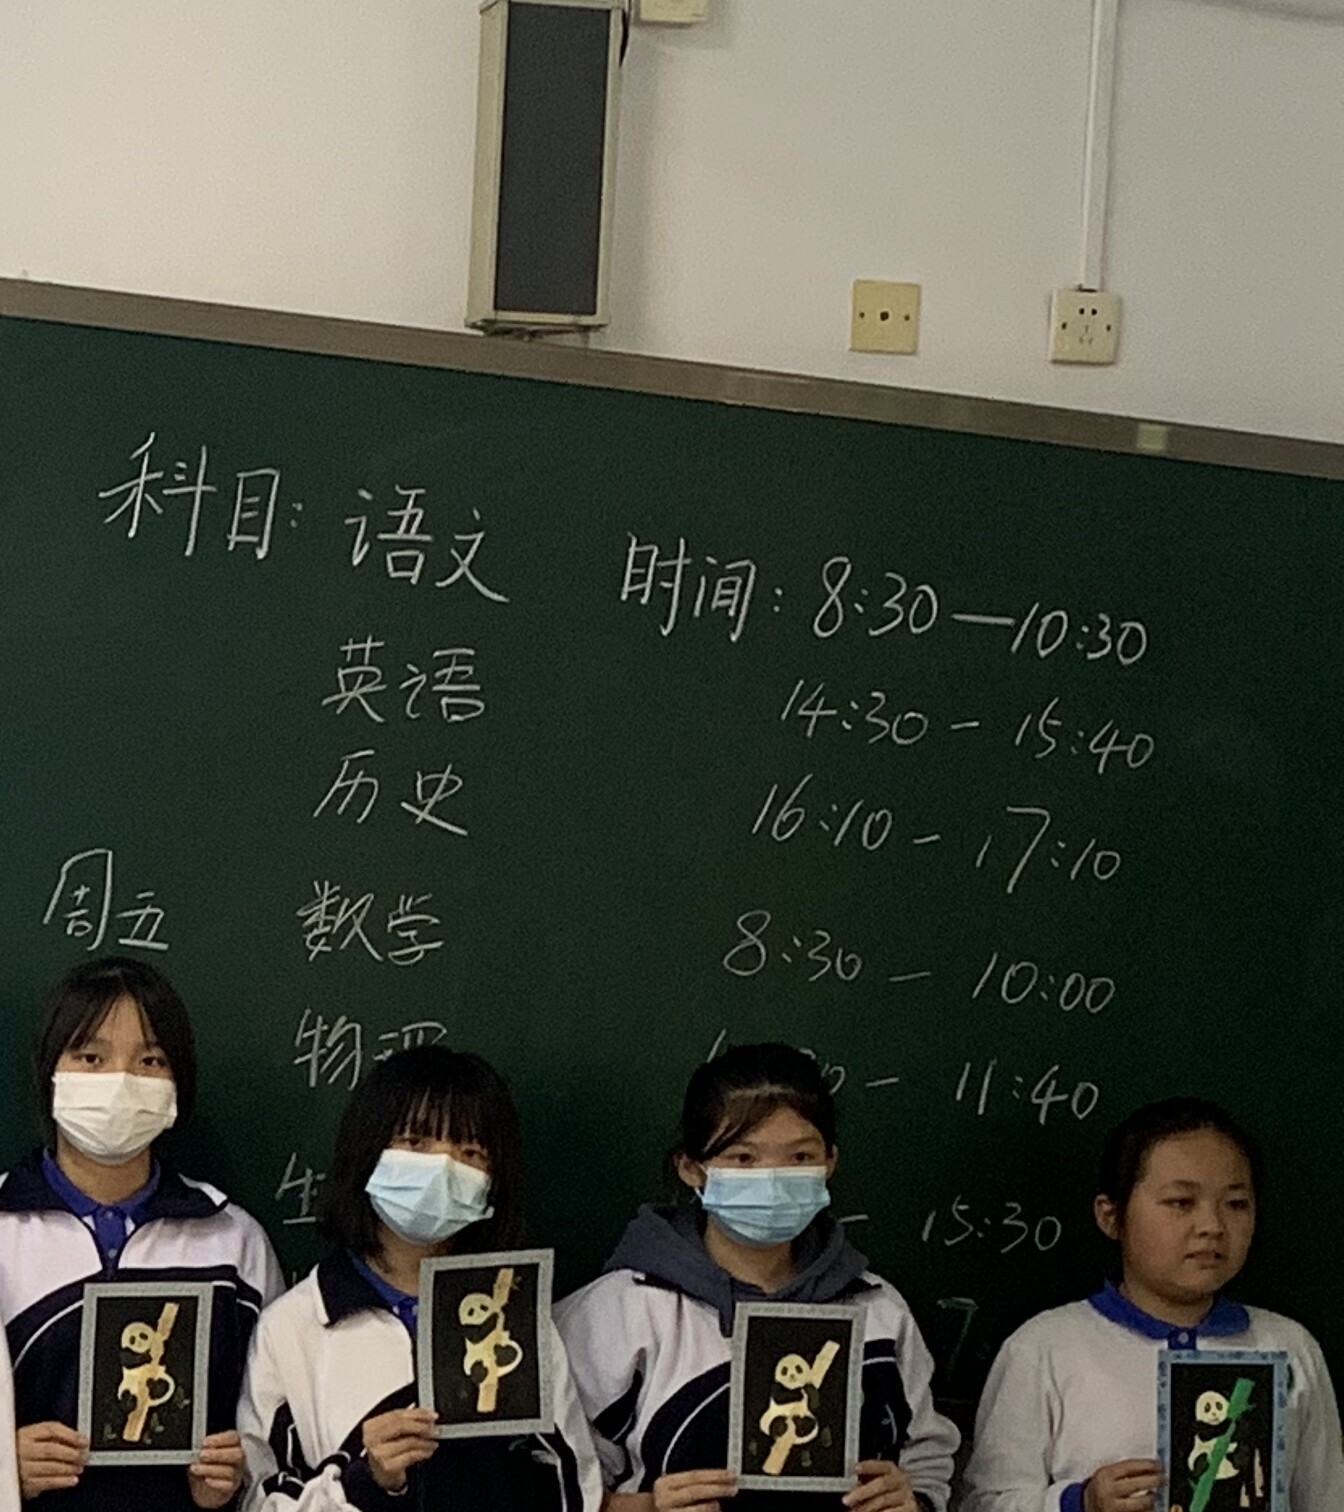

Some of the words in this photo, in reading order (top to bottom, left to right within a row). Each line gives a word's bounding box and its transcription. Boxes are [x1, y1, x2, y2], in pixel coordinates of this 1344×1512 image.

[343, 483, 511, 604] 语文
[321, 633, 486, 724] 英语
[312, 748, 469, 836] 历史
[41, 847, 170, 951] 周五
[295, 879, 445, 966] 数学
